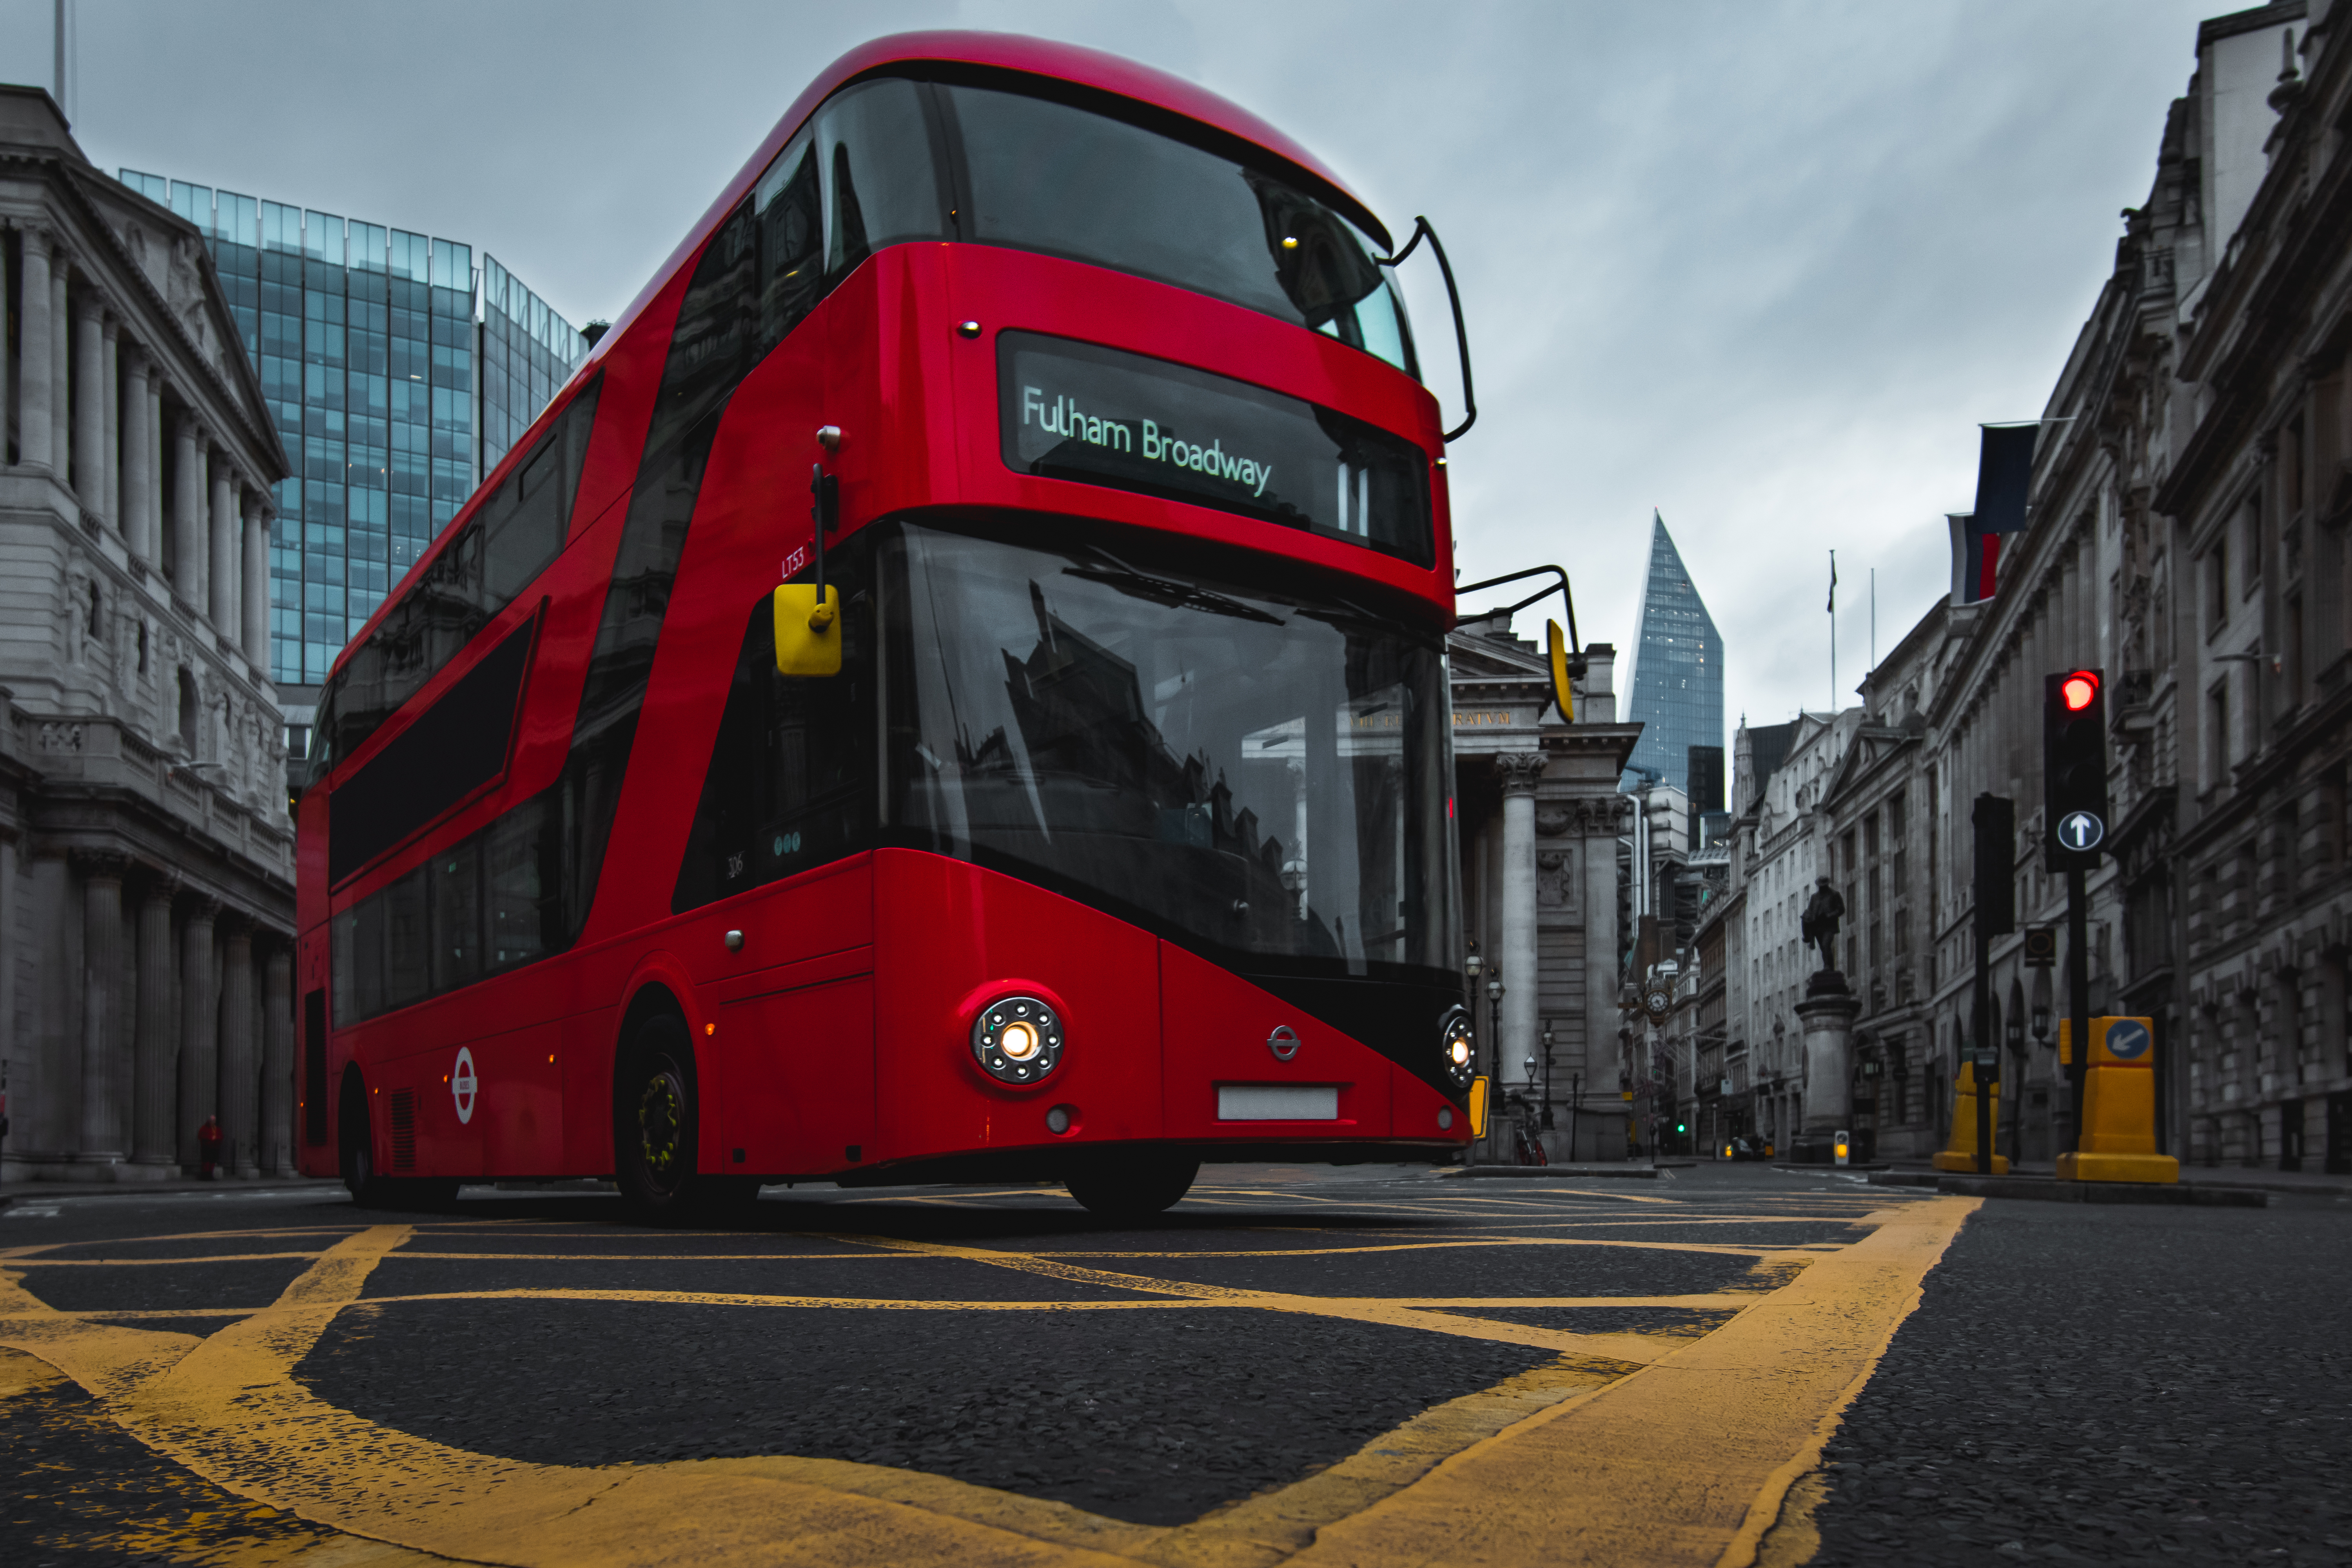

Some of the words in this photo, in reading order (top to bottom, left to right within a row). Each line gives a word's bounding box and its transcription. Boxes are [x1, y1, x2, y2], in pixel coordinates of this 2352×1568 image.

[1023, 385, 1131, 452] Fulham
[1143, 419, 1271, 497] Broadway
[782, 546, 804, 579] LT53
